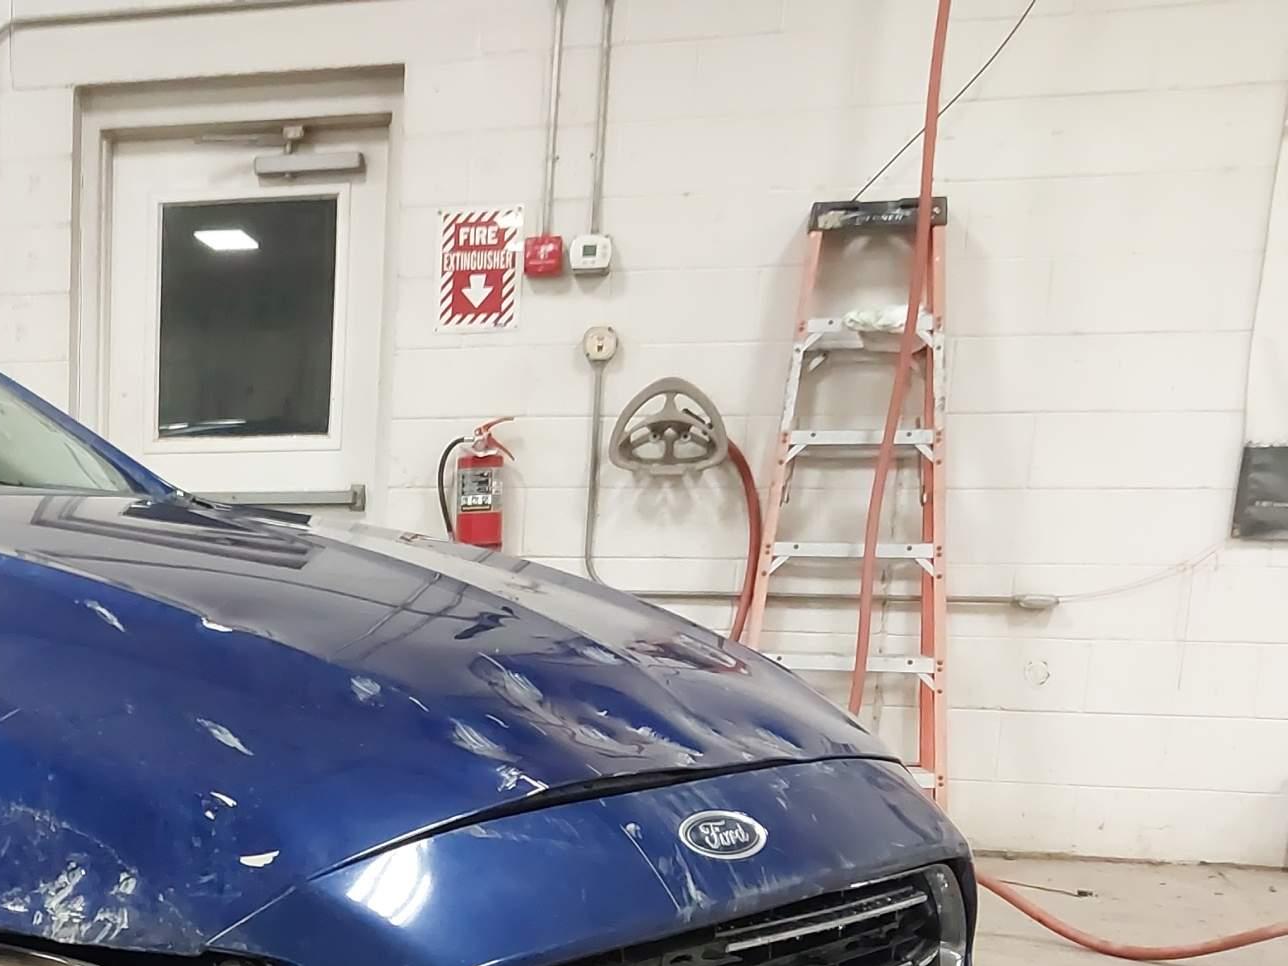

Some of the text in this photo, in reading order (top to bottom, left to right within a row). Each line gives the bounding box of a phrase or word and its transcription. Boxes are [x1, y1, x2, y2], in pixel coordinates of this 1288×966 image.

[459, 226, 498, 246] FIRE
[443, 249, 513, 271] EXTINGUISHER
[699, 819, 750, 849] Ford
